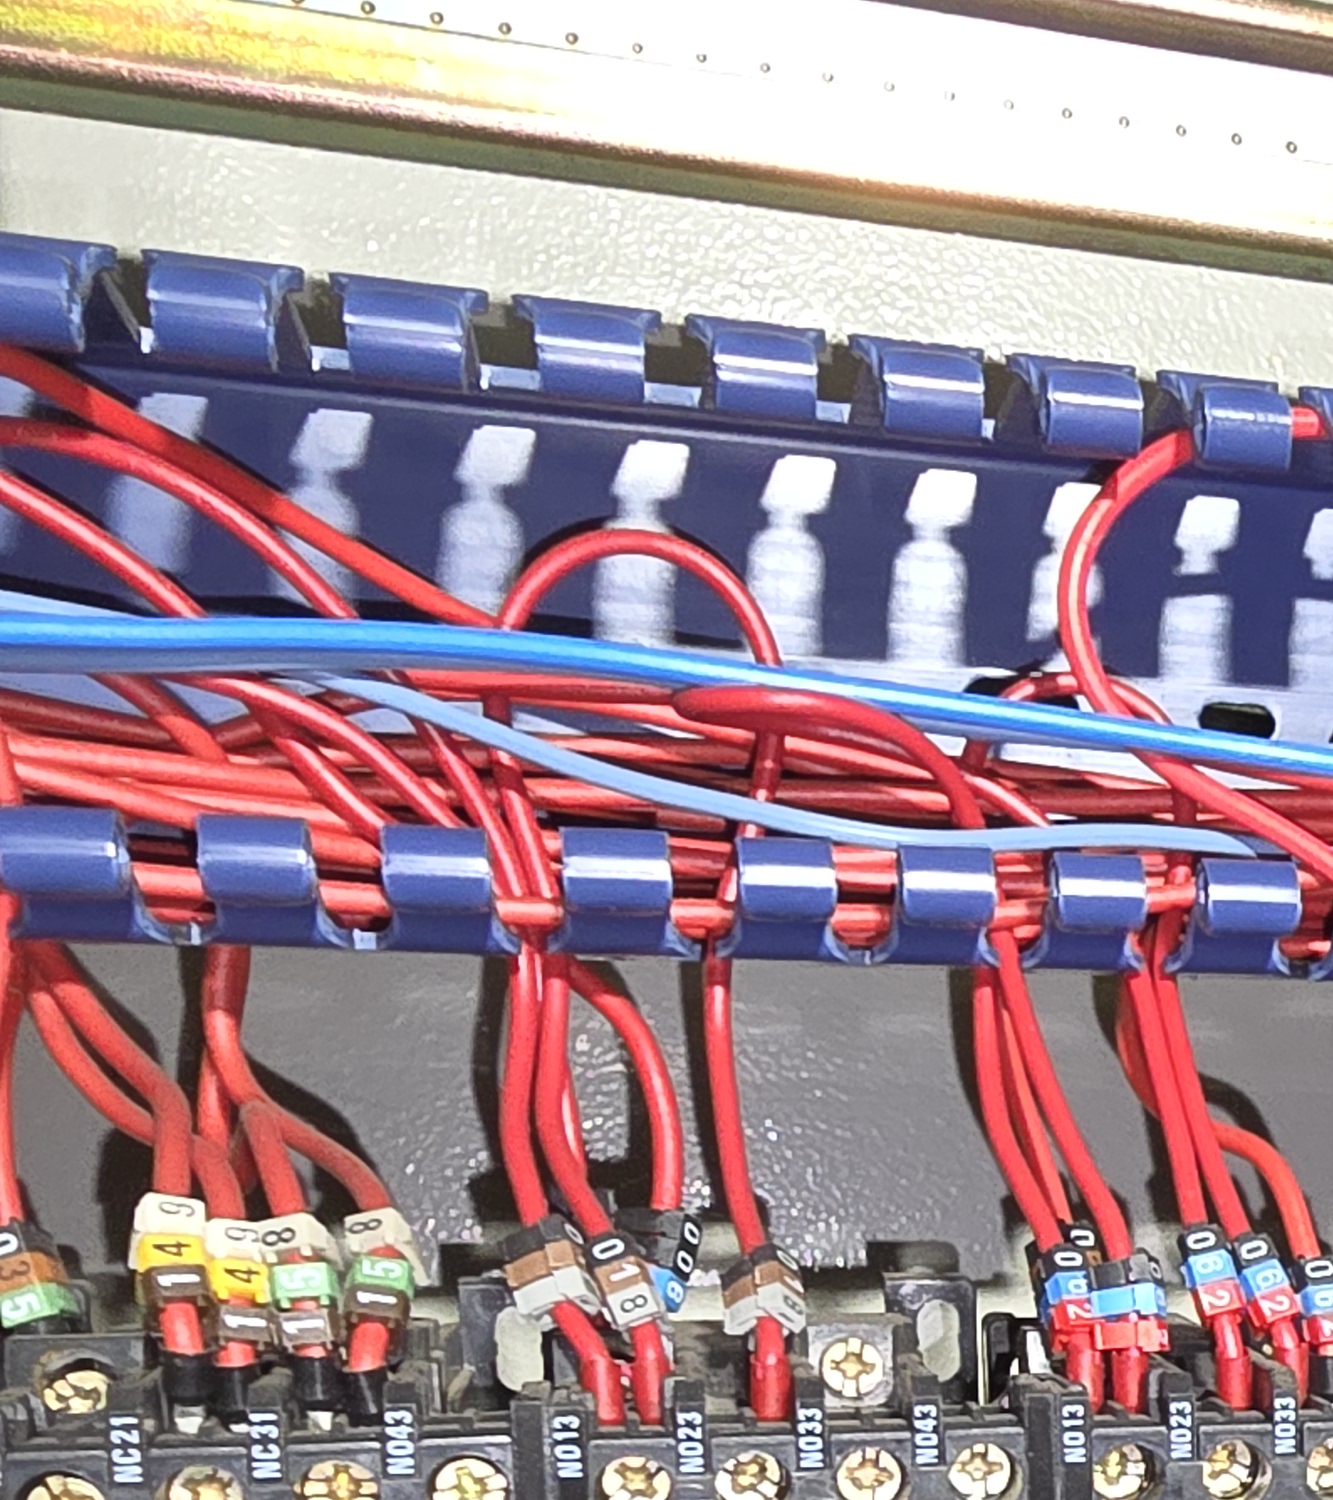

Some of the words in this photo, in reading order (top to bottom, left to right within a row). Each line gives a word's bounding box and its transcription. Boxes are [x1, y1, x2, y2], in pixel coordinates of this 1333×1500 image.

[110, 1416, 144, 1484] NC21
[248, 1410, 282, 1480] NC31
[383, 1410, 414, 1475] NO43
[553, 1413, 584, 1479] NO13
[677, 1411, 706, 1474] NO23
[797, 1407, 825, 1469] NO33
[914, 1404, 940, 1465] NO43
[1061, 1403, 1087, 1464] NO13
[1168, 1399, 1193, 1461] NO23
[1272, 1394, 1297, 1455] NO33
